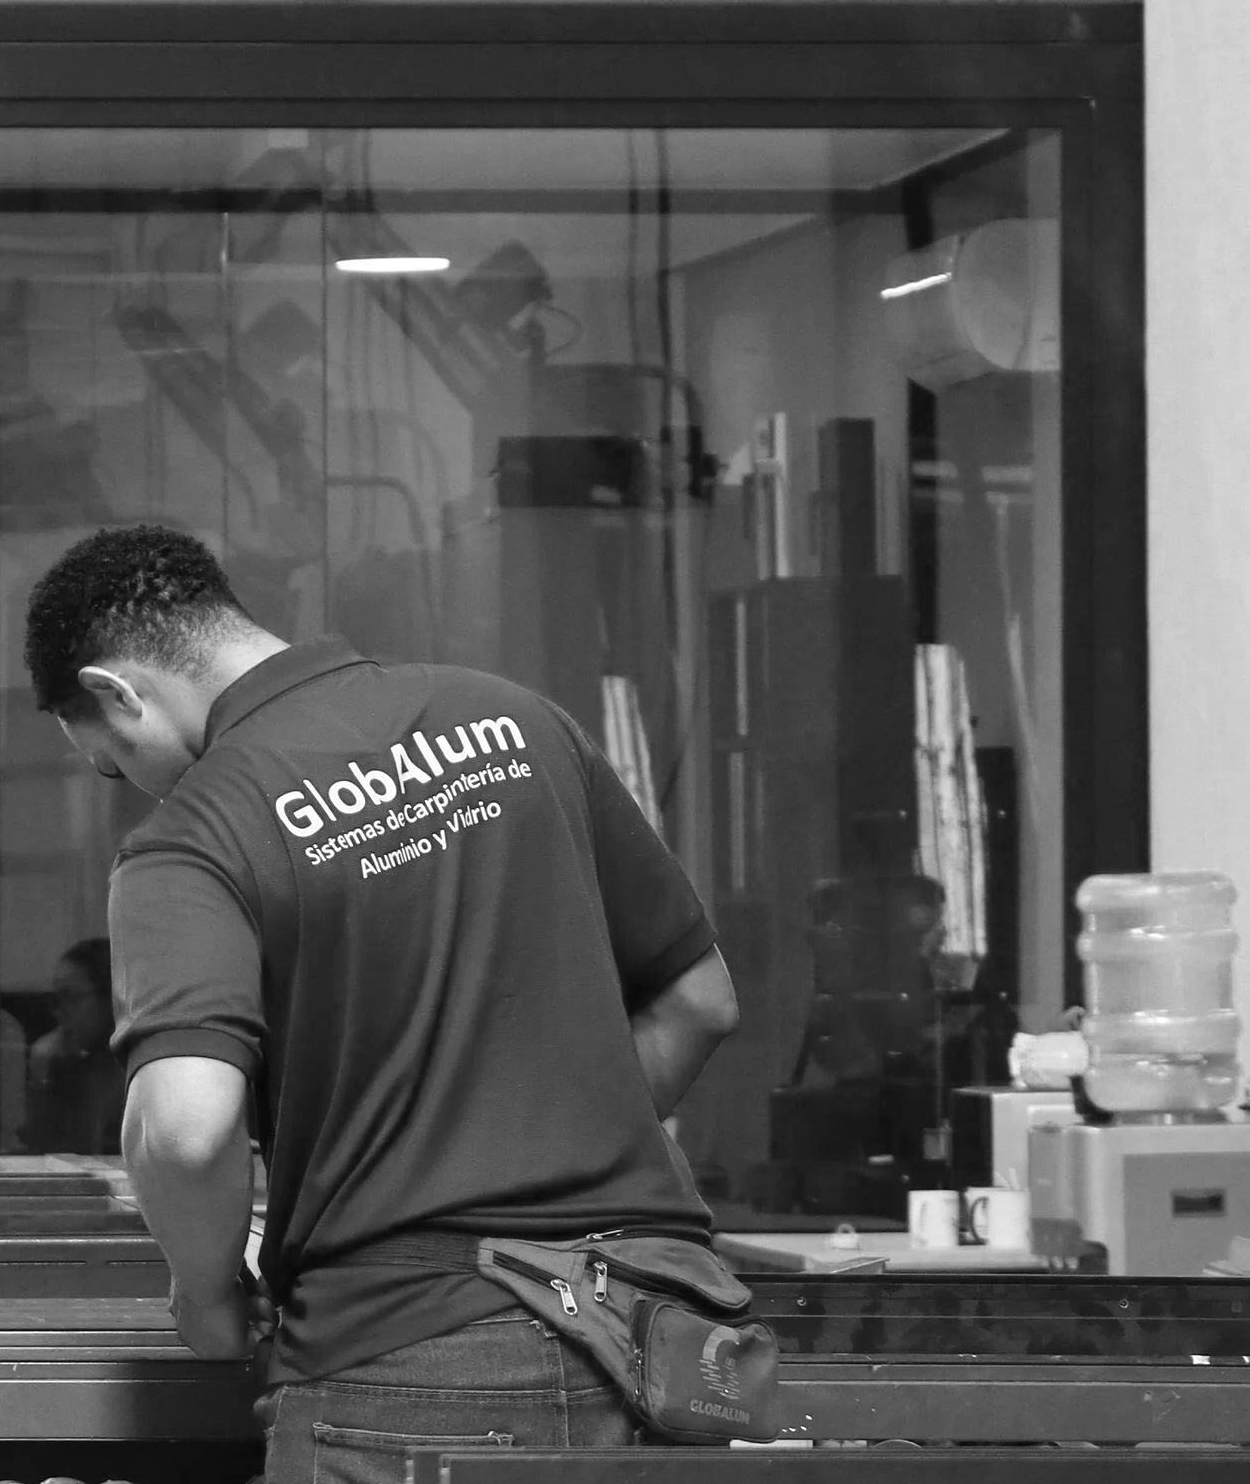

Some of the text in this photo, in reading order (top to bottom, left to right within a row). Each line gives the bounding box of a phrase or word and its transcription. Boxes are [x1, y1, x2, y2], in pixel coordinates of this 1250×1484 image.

[275, 714, 527, 838] GlobAlum
[305, 758, 532, 865] Sistemas de Carpintería de
[360, 800, 501, 879] Aluminio y Vidrio
[689, 1398, 750, 1425] GLOBALUM
